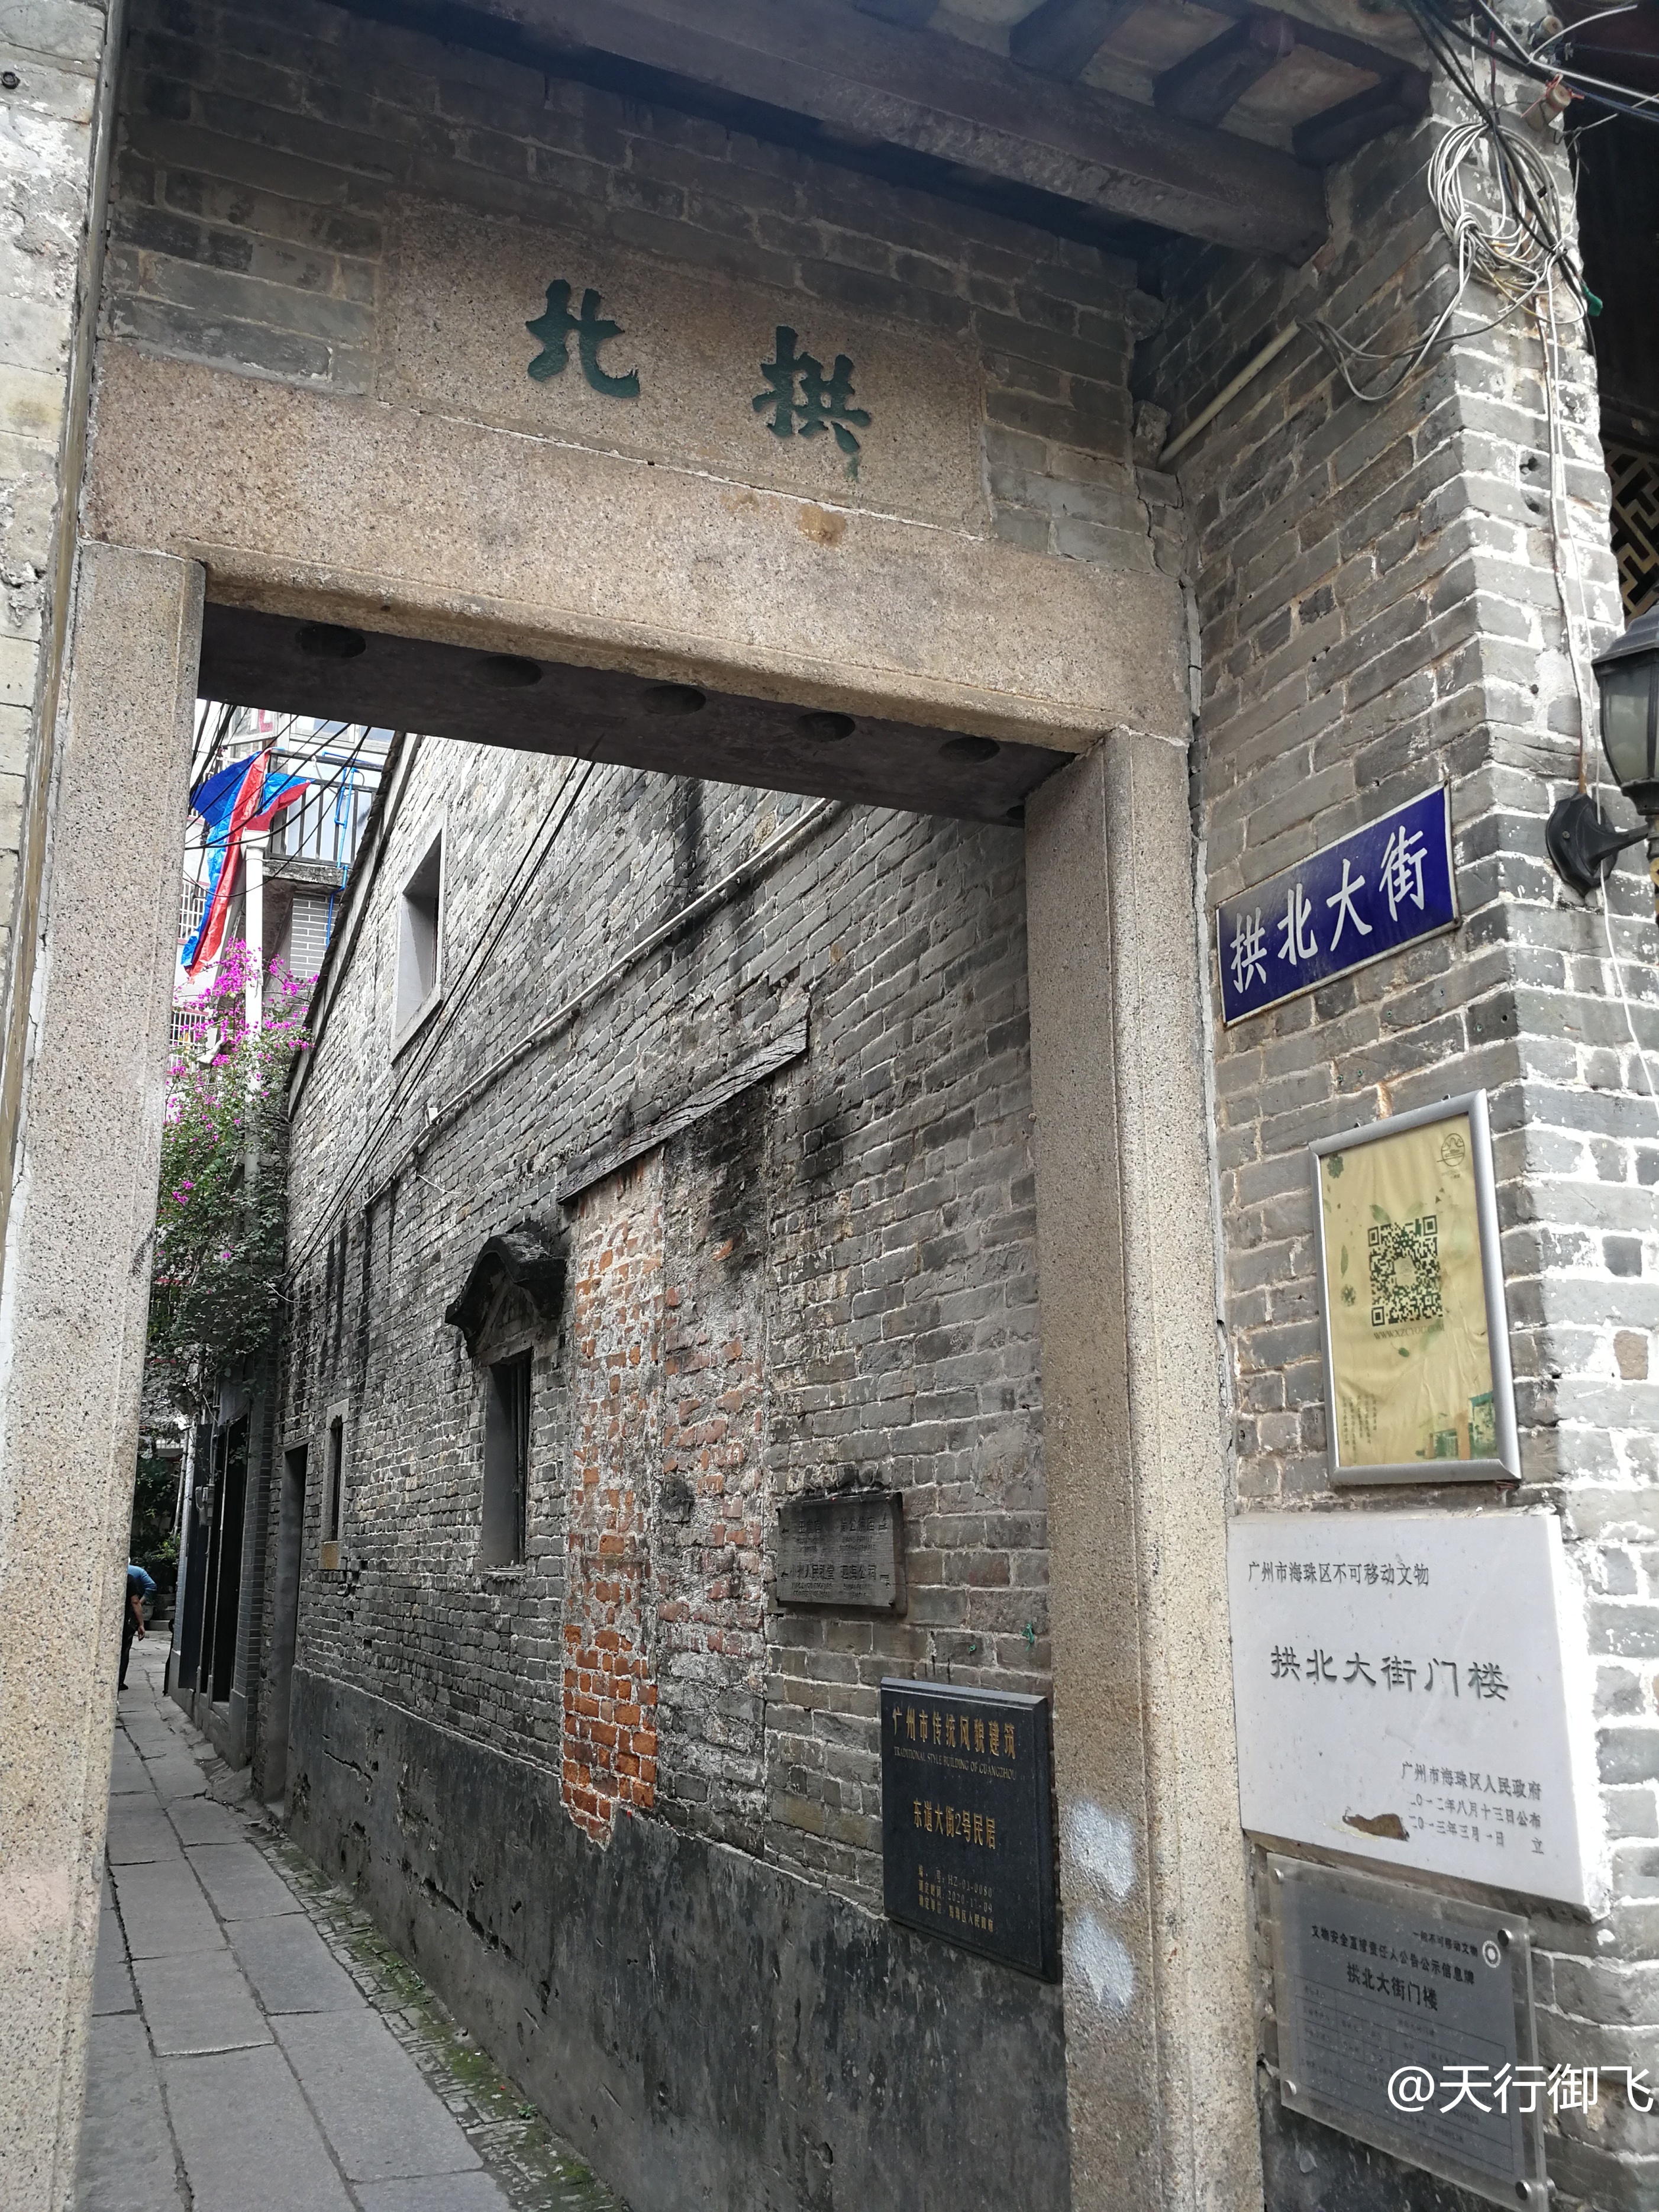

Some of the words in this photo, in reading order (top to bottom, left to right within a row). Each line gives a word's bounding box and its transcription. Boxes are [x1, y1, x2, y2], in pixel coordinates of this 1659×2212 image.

[1231, 825, 1428, 994] 拱北大街
[1248, 1561, 1429, 1586] 广州市海珠区不可移动文物
[1270, 1645, 1509, 1700] 拱北大街门楼
[892, 1705, 1015, 1760] 广州市传统风貌建筑
[893, 1746, 926, 1762] TRADITIONAL
[927, 1753, 943, 1765] STYLE
[943, 1756, 969, 1771] BUILDING
[970, 1760, 978, 1772] OF
[978, 1762, 1016, 1781] GUANGZHOU
[1401, 1761, 1541, 1800] 广州市海珠区人民政府
[914, 1798, 996, 1849] 东道大街2号民居
[1531, 1837, 1544, 1855] 立
[1347, 1962, 1438, 2011] 拱北大街门楼
